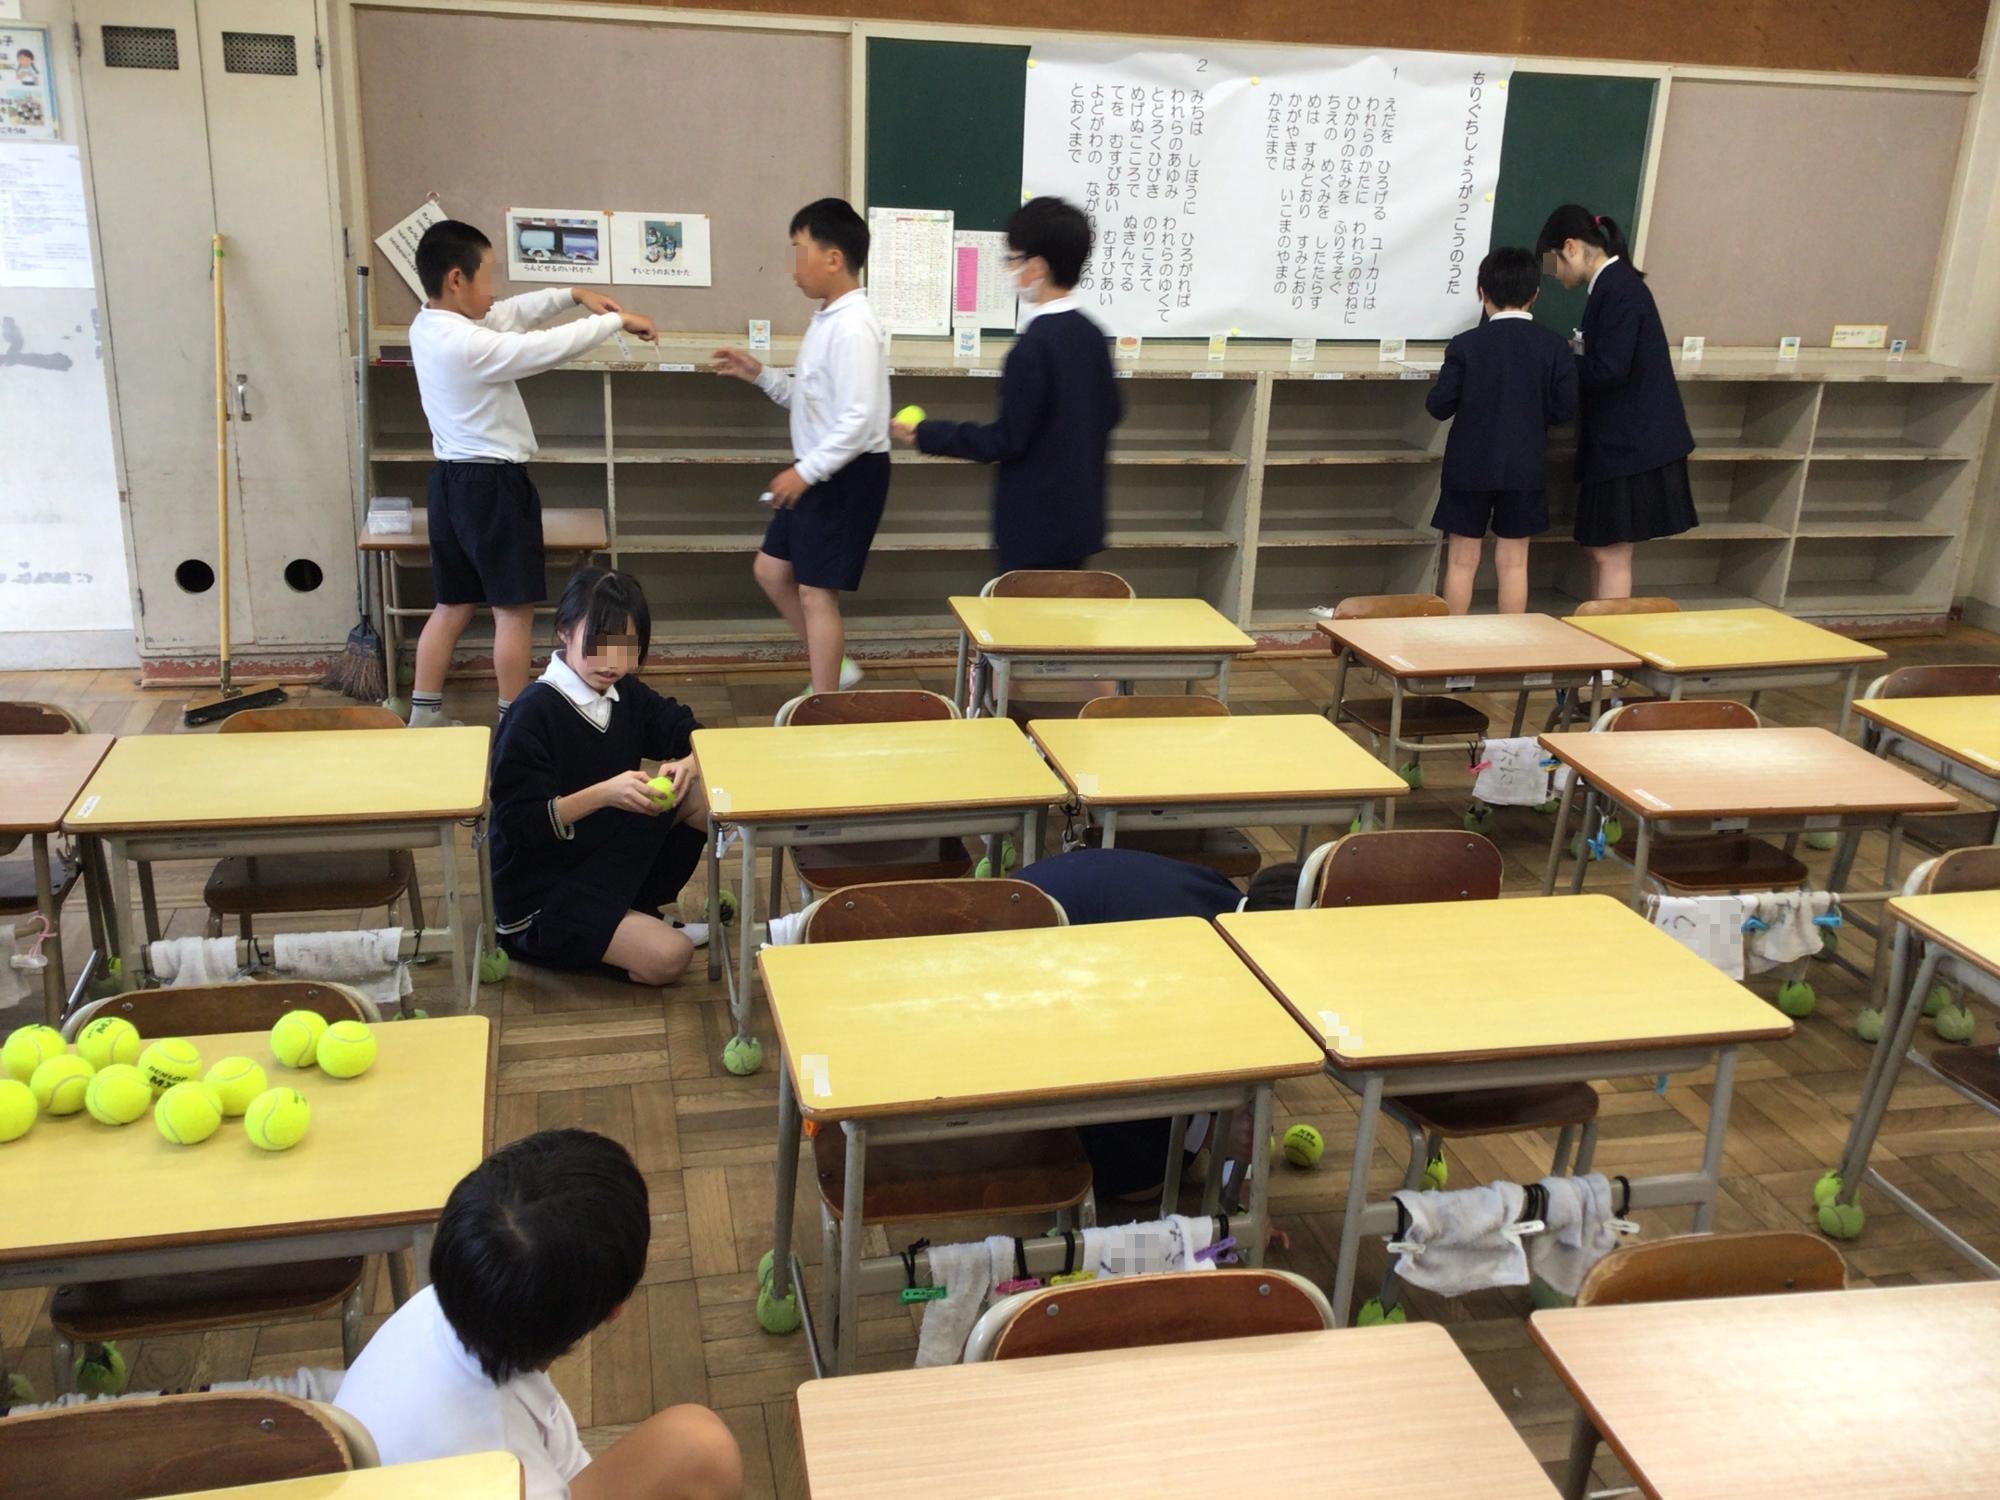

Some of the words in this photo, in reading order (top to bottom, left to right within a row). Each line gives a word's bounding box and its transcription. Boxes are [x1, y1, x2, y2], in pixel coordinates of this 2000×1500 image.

[1111, 85, 1125, 117] てを
[1196, 58, 1209, 73] 2
[1392, 66, 1398, 80] 1
[1068, 82, 1085, 164] とおくまで
[1087, 84, 1105, 164] よどがわの
[1126, 86, 1146, 199] めげぬこころで
[1146, 86, 1165, 199] とどろくひびき
[1164, 88, 1185, 199] われらのあゆみ
[1189, 89, 1205, 136] みちは
[1265, 92, 1283, 171] かなたまで
[1283, 92, 1303, 172] かがやきは
[1306, 93, 1322, 125] めは
[1324, 94, 1341, 141] ちえの
[1381, 97, 1397, 144] えだを
[1105, 133, 1123, 213] むすびあい
[1183, 153, 1201, 215] しほうに
[1299, 141, 1317, 219] すみとおり
[1338, 96, 1361, 204] ひかりのなみを
[1355, 97, 1380, 204] われらのかたに
[1446, 71, 1486, 295] もりぐちしょうがっこうのうた
[1317, 159, 1335, 219] めぐみを
[1373, 160, 1392, 221] ひろげる
[1099, 230, 1117, 306] むすびあい
[1120, 215, 1138, 292] ぬきんでる
[1139, 216, 1157, 293] のりこえて
[1157, 216, 1176, 323] われらのゆくて
[1176, 231, 1195, 308] ひろがれば
[1273, 188, 1294, 295] いこまのやまの
[1292, 235, 1309, 310] すみとおり
[1309, 235, 1328, 310] したたらす
[1329, 220, 1347, 294] ふりそそぐ
[1344, 221, 1366, 325] われらのむねに
[1363, 237, 1384, 310] ユーカリは
